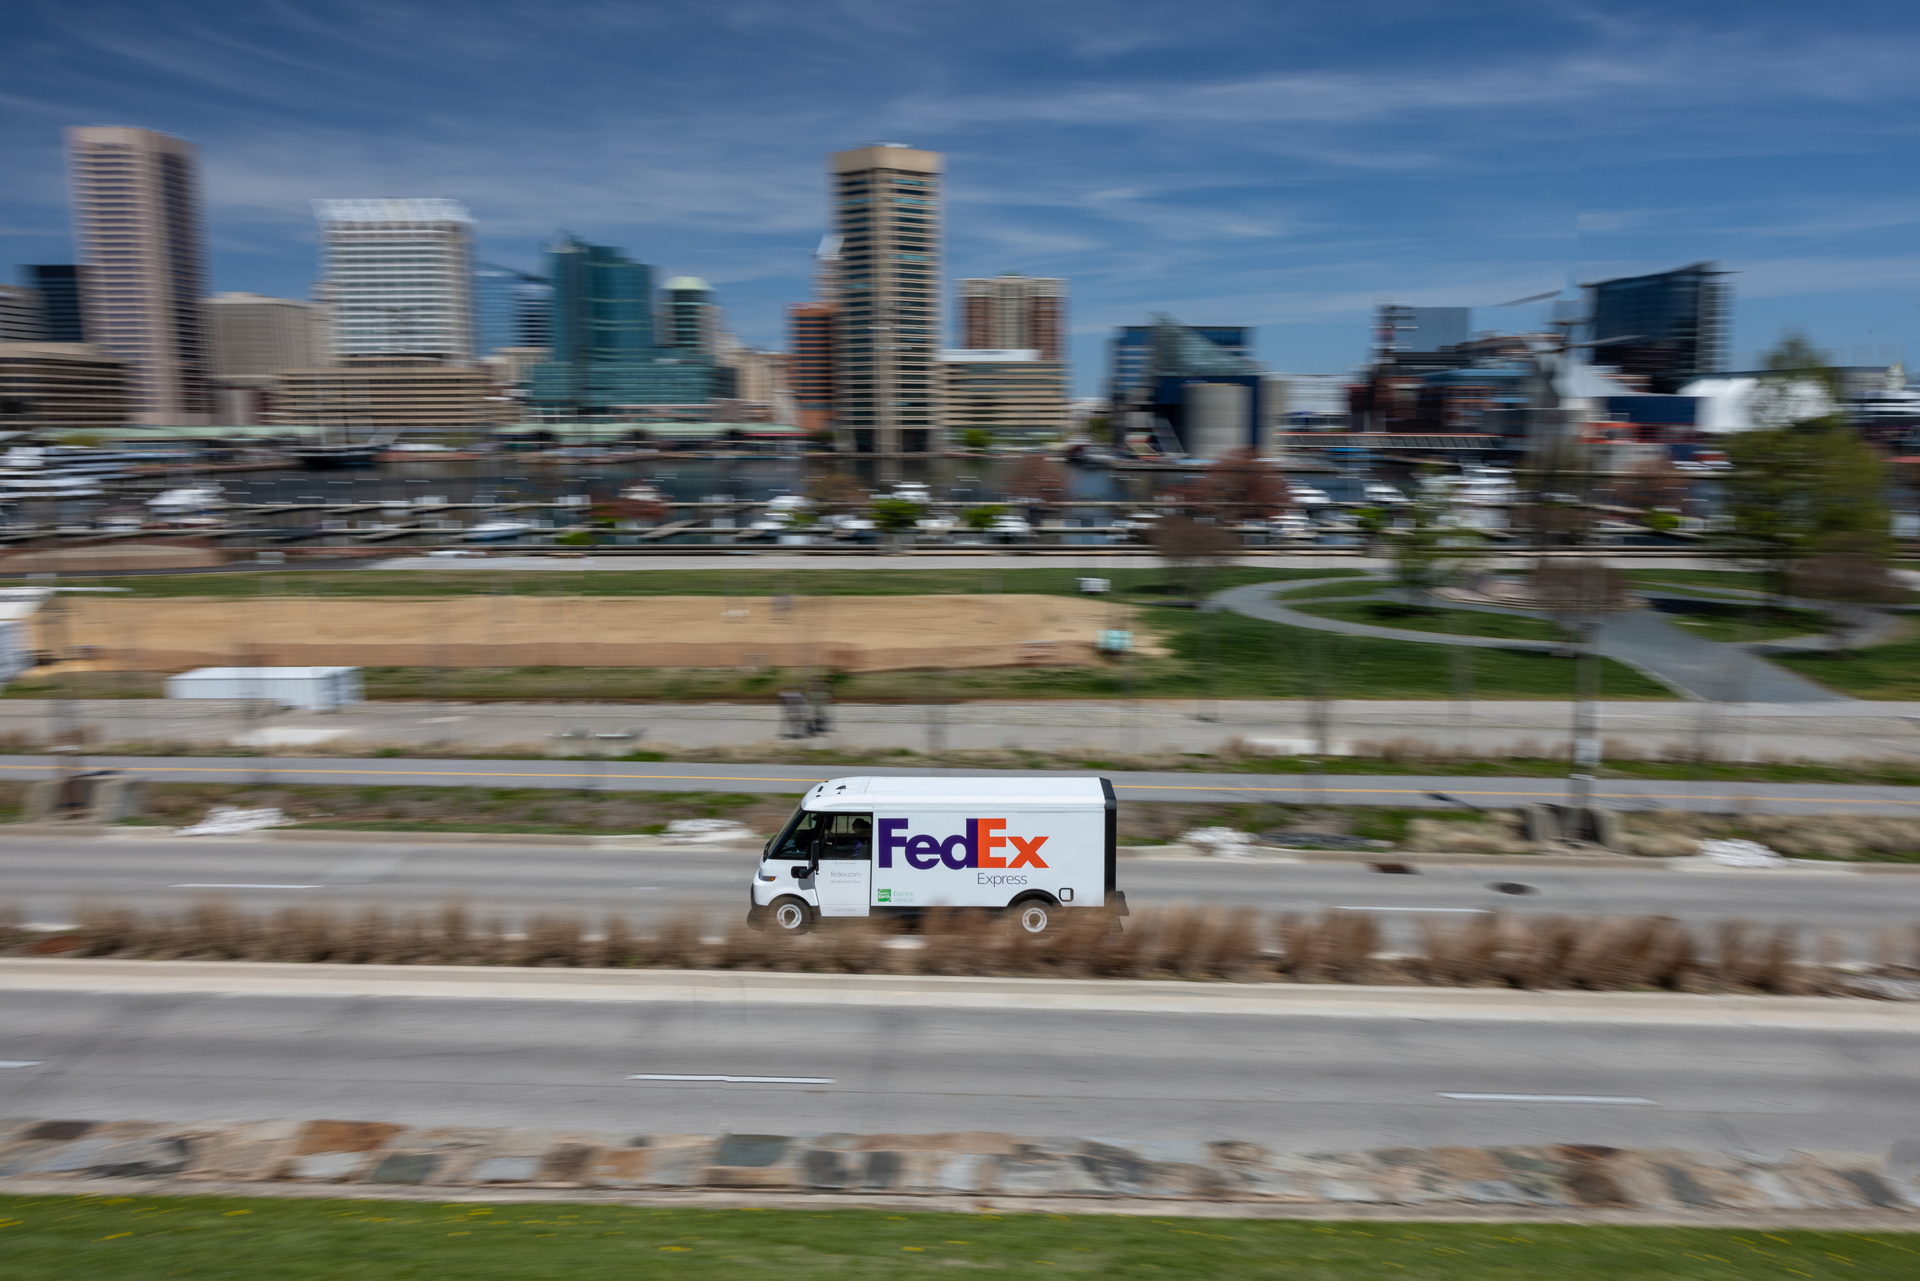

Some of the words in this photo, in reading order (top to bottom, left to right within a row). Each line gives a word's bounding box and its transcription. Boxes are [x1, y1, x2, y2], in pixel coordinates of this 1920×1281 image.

[878, 818, 1049, 870] FedEx
[830, 870, 861, 878] fedex.com
[977, 872, 1028, 887] Express
